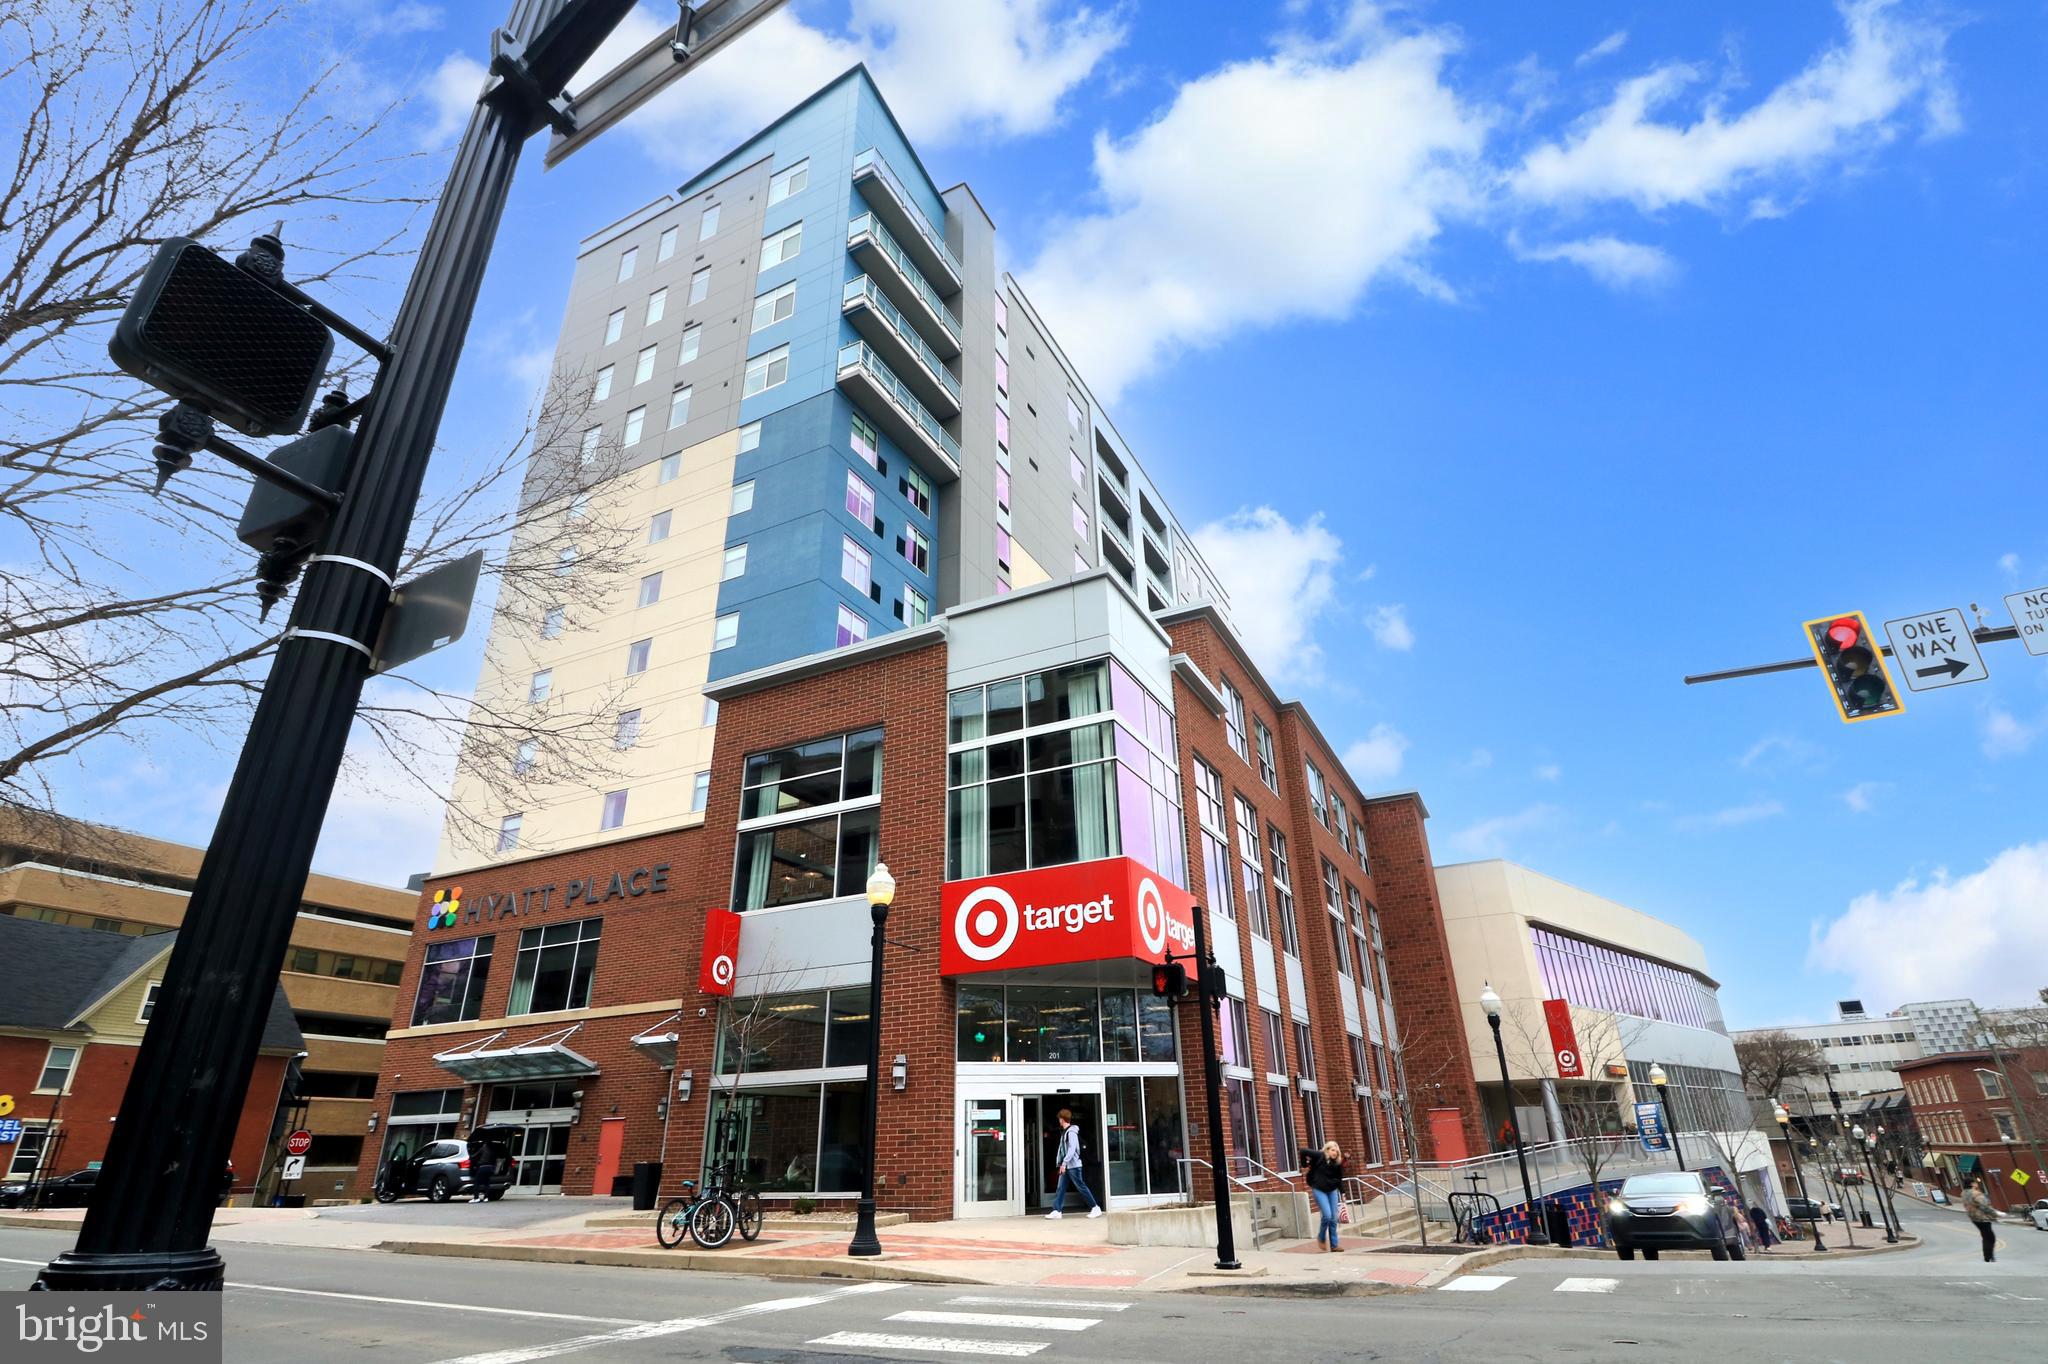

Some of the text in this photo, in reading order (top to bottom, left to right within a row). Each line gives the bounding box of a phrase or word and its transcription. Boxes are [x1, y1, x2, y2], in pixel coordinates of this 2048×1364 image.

[1902, 617, 1951, 640] ONE
[2024, 623, 2045, 636] ON
[1906, 636, 1957, 659] WAY
[463, 862, 671, 925] HYATT PLACE
[1023, 894, 1115, 933] target
[1165, 910, 1196, 951] targe
[1049, 1052, 1060, 1060] 201
[290, 1138, 310, 1147] STOP
